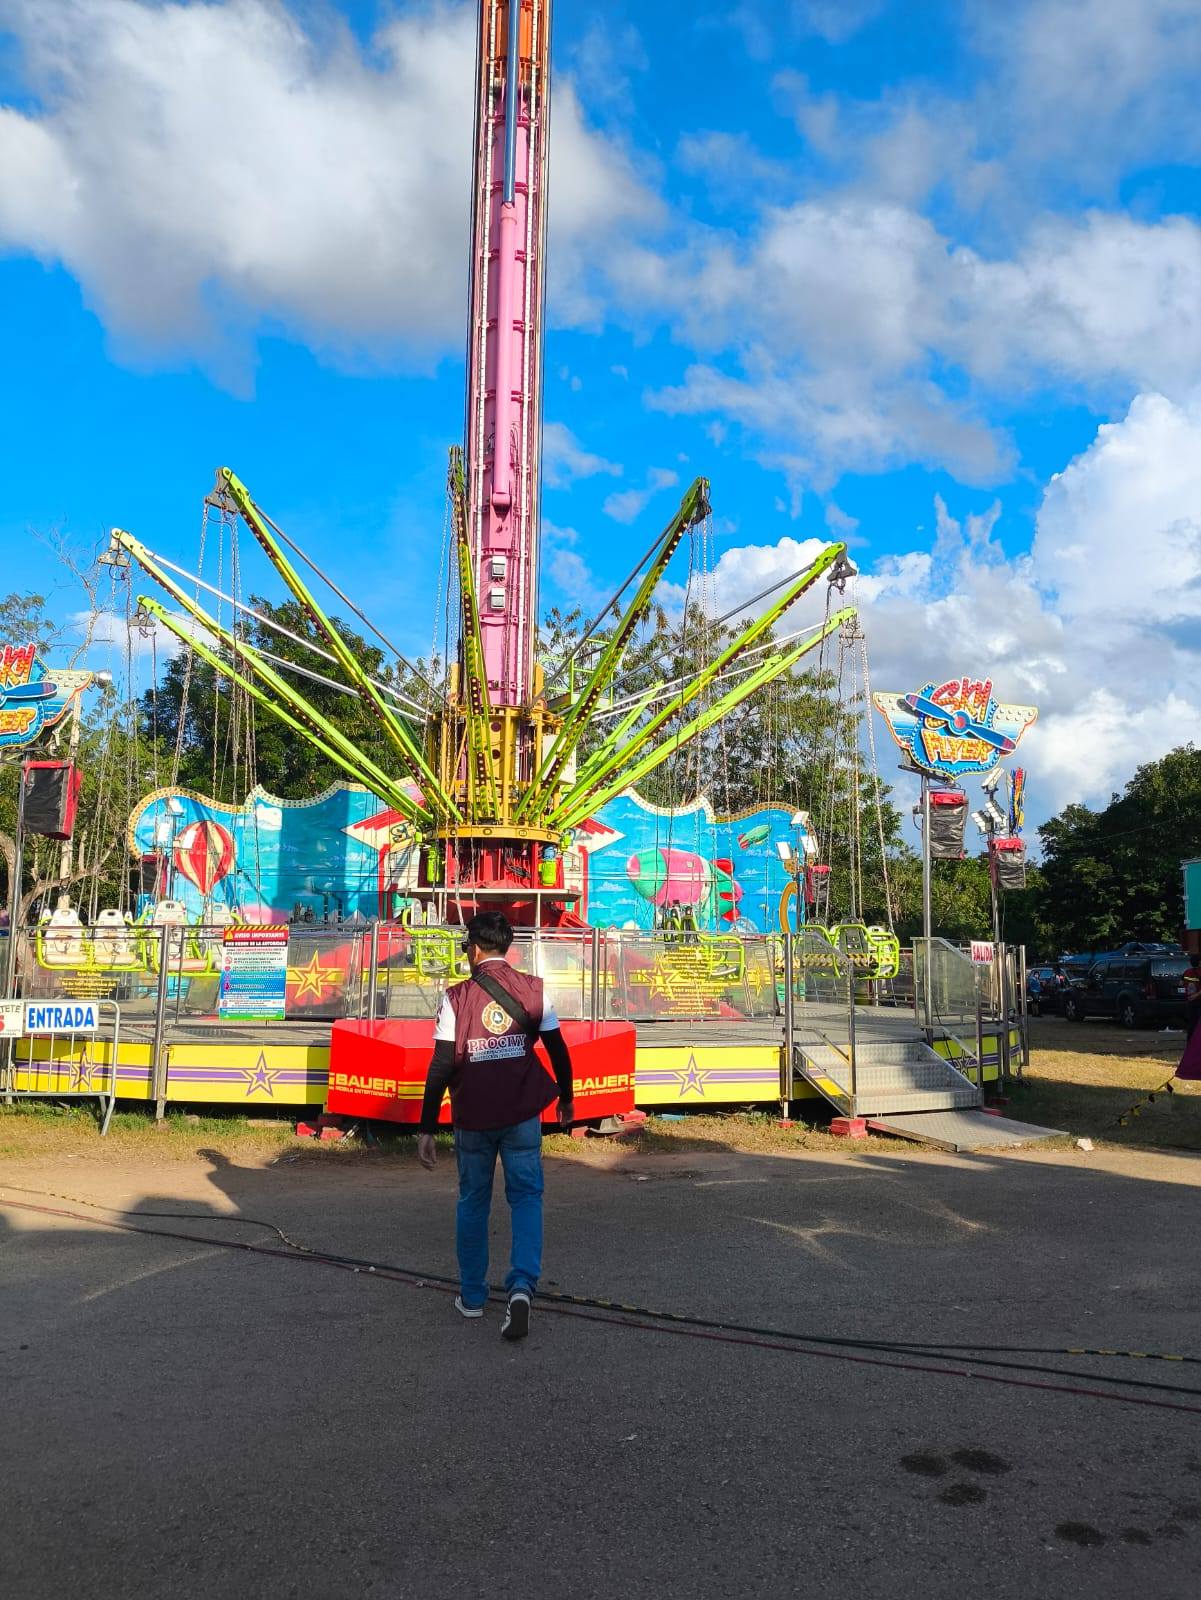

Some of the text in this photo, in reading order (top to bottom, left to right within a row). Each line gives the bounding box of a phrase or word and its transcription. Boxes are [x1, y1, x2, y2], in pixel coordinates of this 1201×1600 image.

[926, 677, 993, 727] SKY
[921, 730, 995, 764] FLYER
[973, 944, 992, 961] SALIDA
[28, 1007, 94, 1028] ENTRADA
[468, 1034, 526, 1053] PROCIVY
[335, 1073, 396, 1092] BAUER
[335, 1085, 396, 1098] MOBILE ENTERTAINMENT
[573, 1074, 629, 1092] BAUER
[589, 1086, 629, 1096] ENTERTAINMENT
